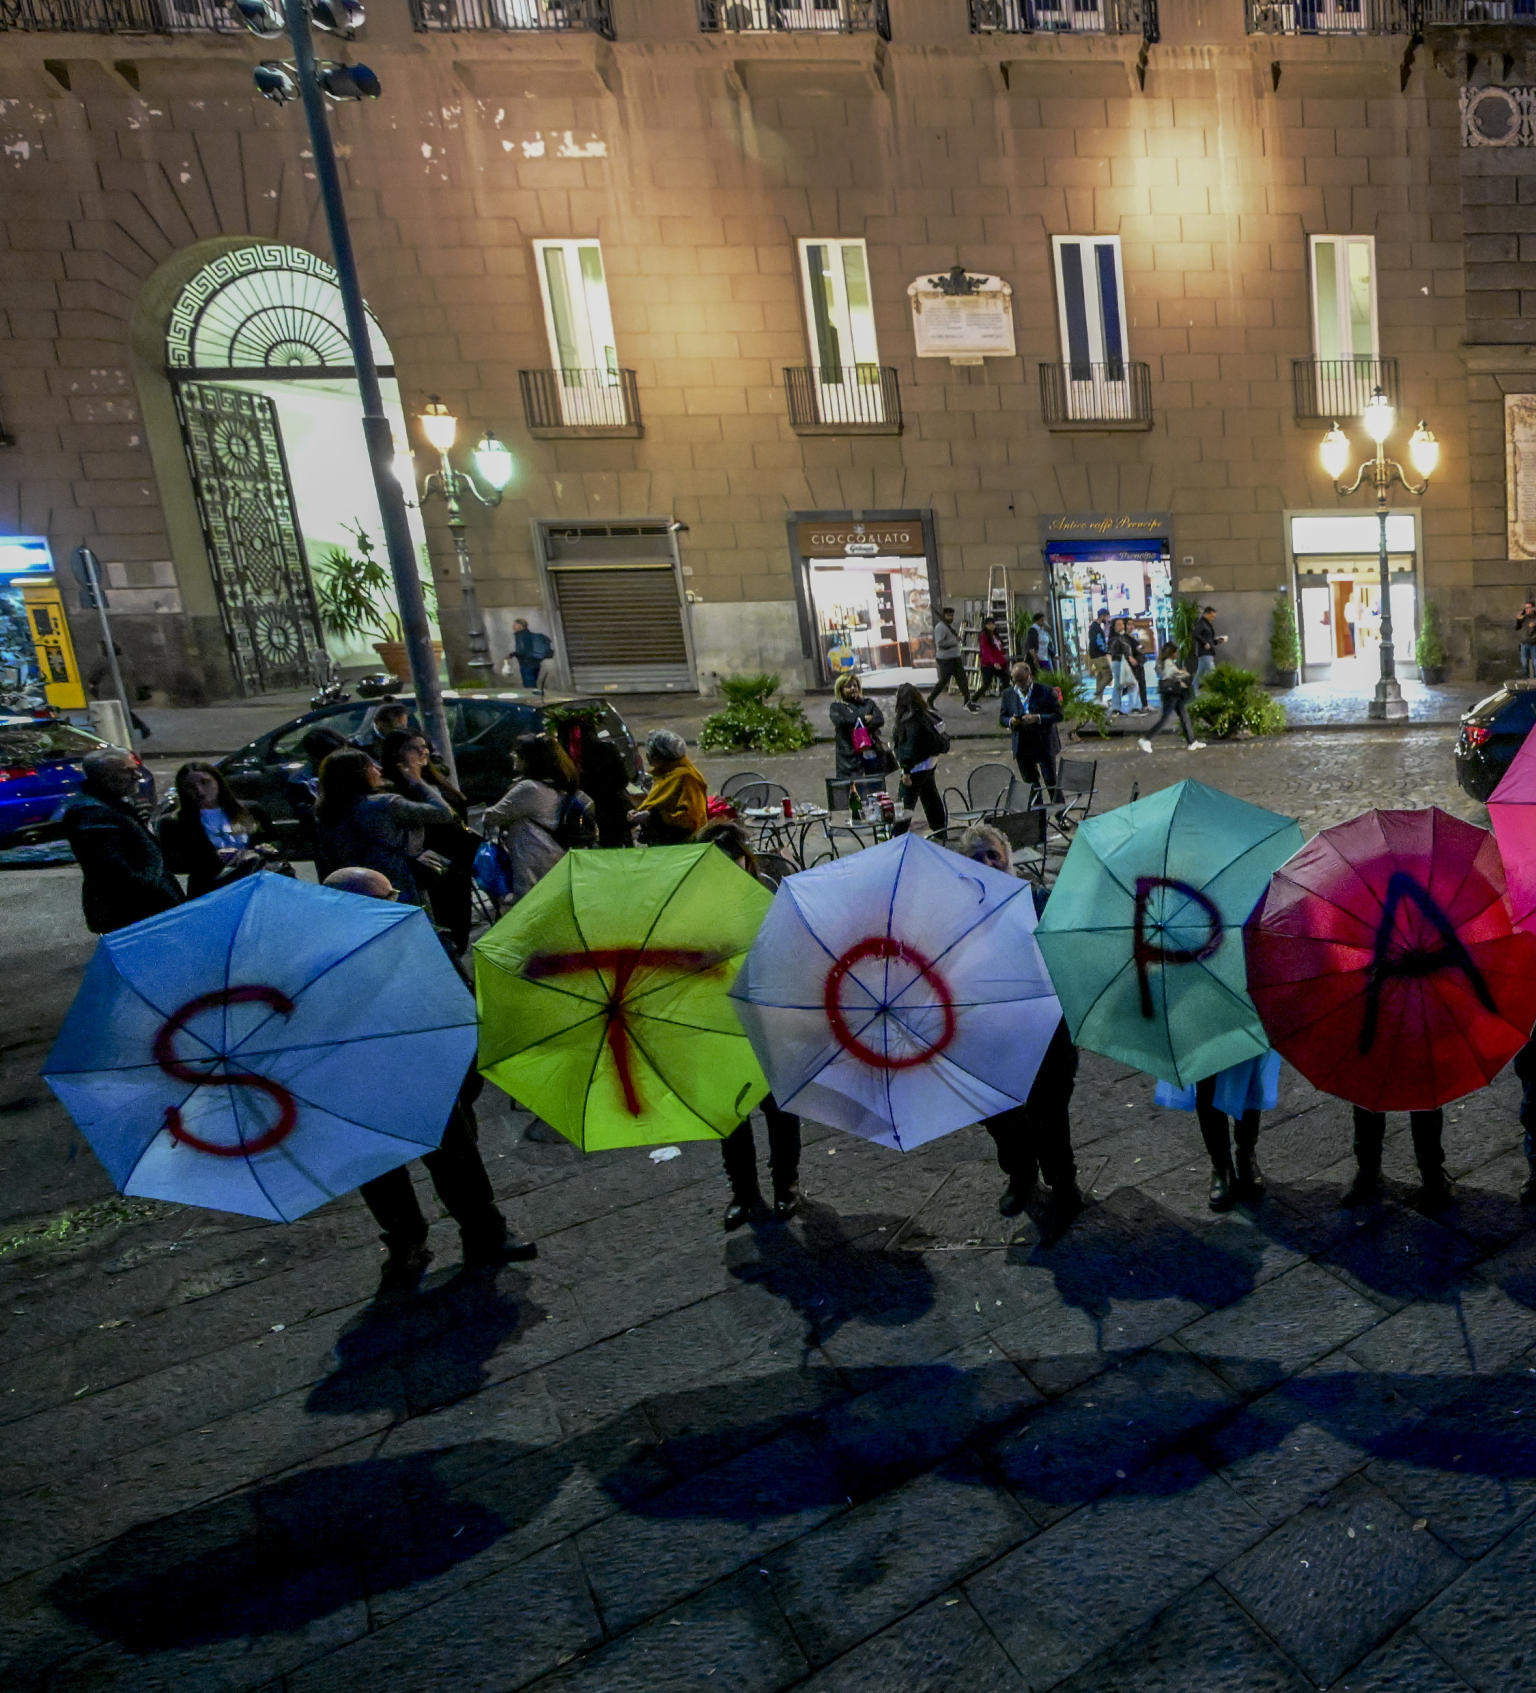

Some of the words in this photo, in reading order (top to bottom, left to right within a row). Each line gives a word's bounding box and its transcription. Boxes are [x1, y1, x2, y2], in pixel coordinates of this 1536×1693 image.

[1048, 515, 1087, 530] Antico
[153, 984, 298, 1157] S
[522, 945, 727, 1118] T
[825, 936, 955, 1070] O
[1134, 877, 1222, 1020] P
[1360, 871, 1498, 1055] A
